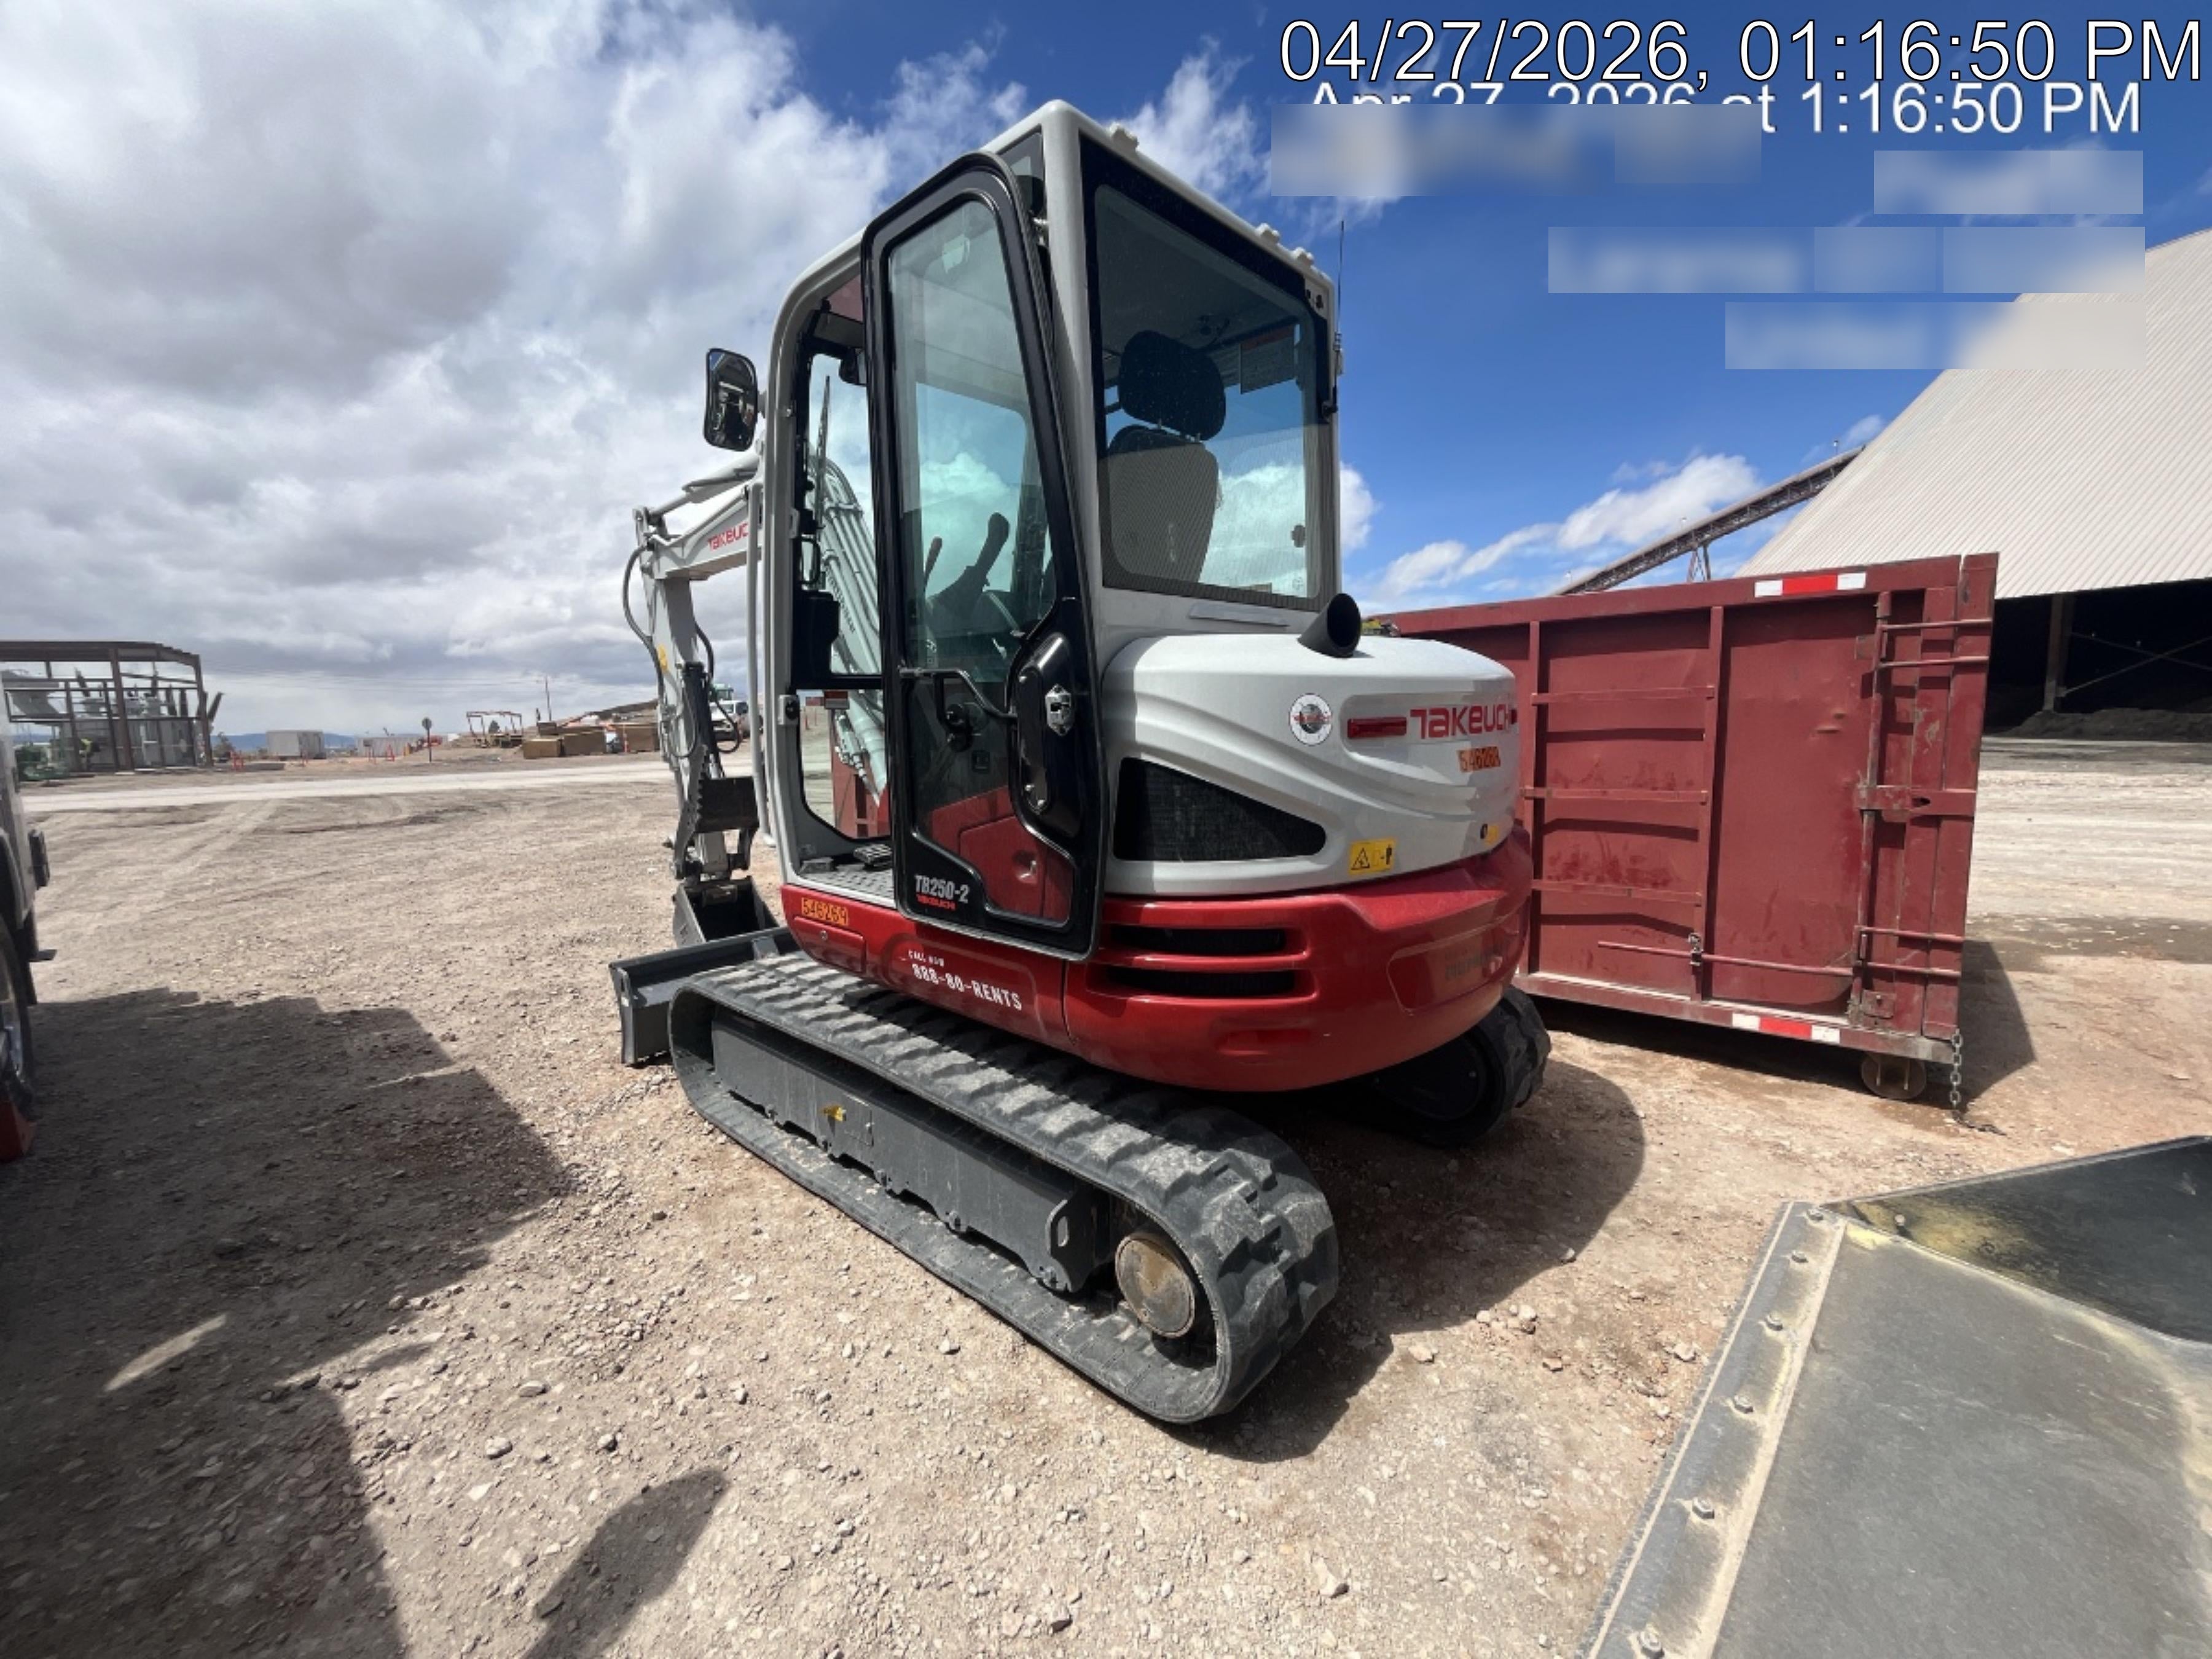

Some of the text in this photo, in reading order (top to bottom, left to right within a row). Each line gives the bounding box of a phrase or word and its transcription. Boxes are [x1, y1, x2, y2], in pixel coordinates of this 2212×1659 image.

[708, 522, 749, 551] TAKEUC
[914, 874, 970, 904] TB250-2
[912, 963, 1022, 1012] 888-80-RENTS
